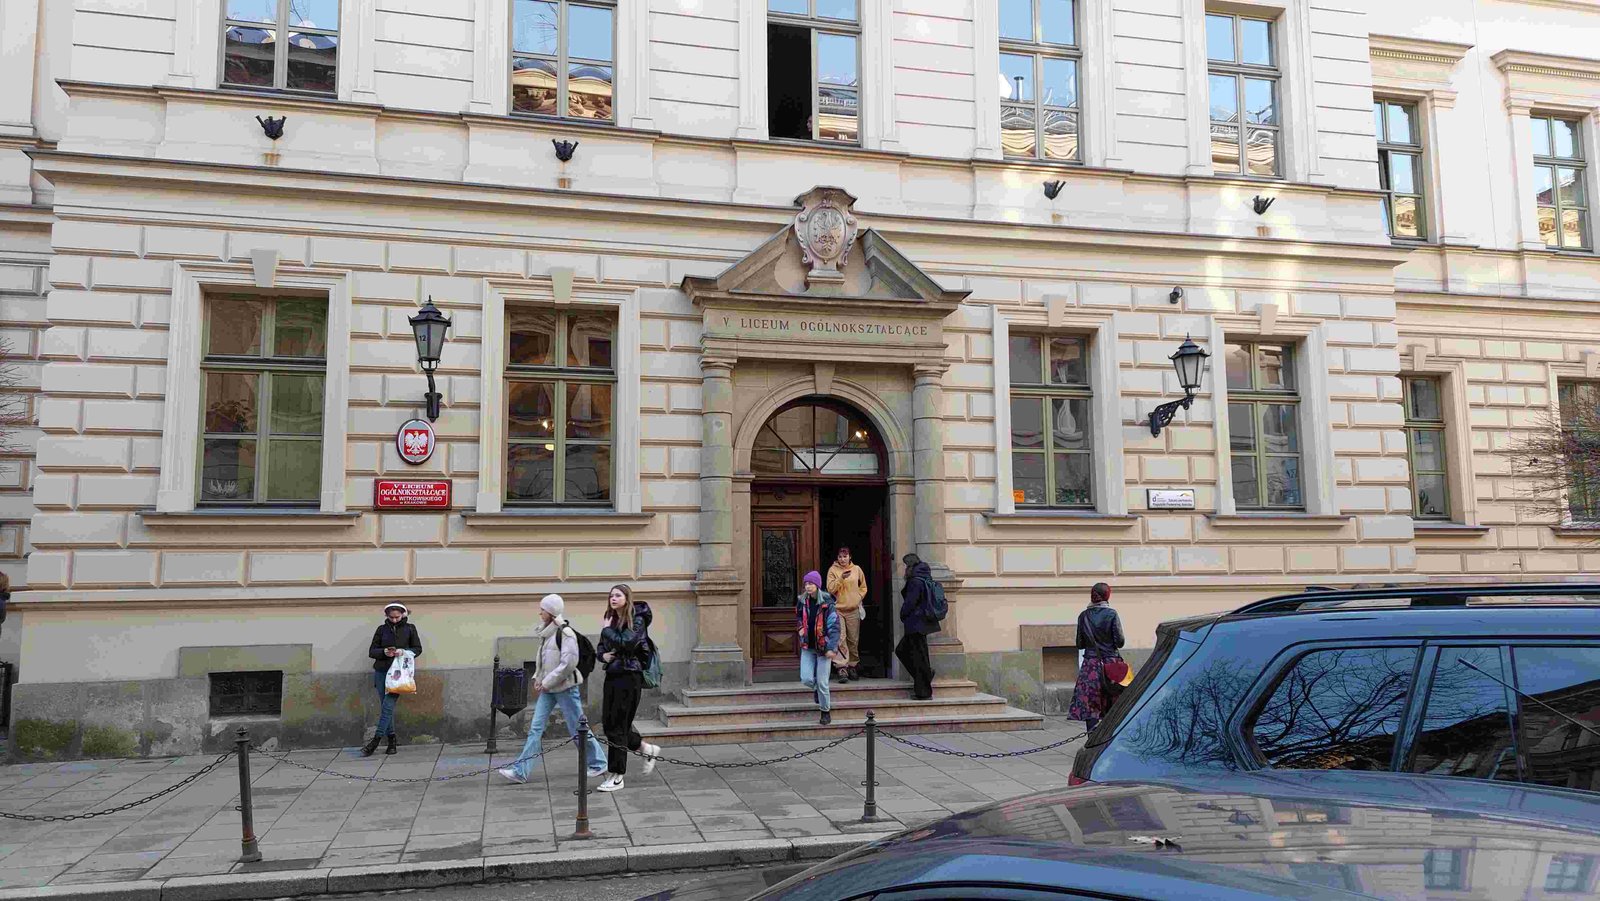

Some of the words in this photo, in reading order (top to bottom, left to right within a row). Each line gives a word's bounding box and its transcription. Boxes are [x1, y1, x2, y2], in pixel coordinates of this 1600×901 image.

[741, 318, 790, 330] LICEUM
[800, 319, 928, 336] OGÓLNOKSZTAŁCĄCE
[380, 487, 446, 496] OGÓLNOKSZTAŁCĄCE
